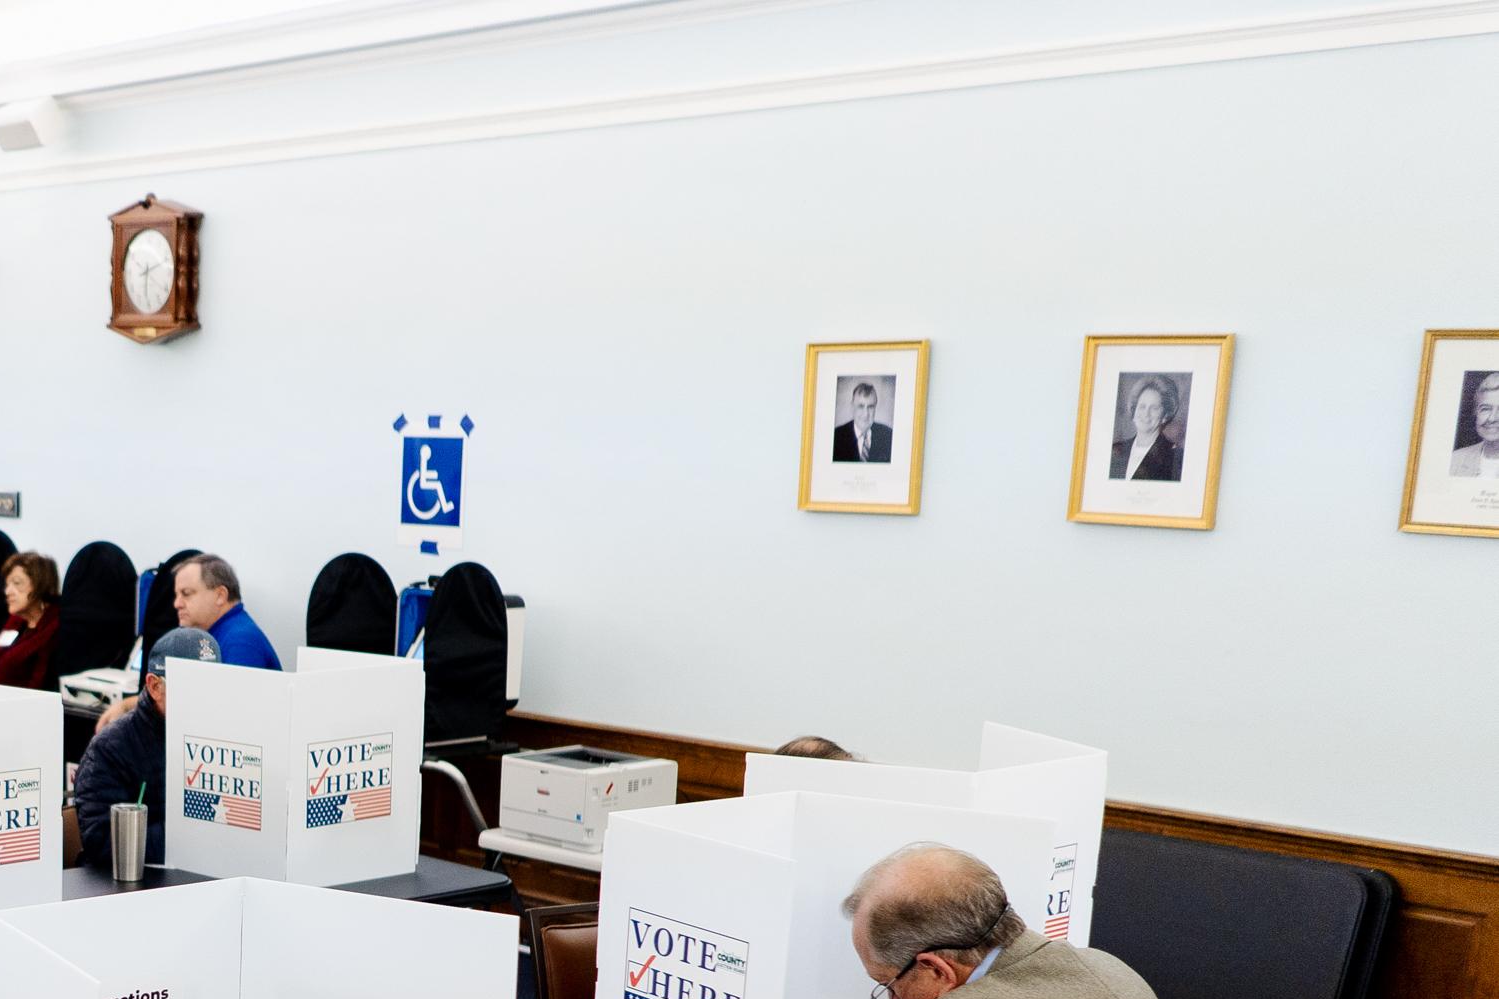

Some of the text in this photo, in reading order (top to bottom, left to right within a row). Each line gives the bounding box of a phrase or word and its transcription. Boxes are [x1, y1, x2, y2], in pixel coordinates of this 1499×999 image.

[185, 742, 243, 769] VOTE
[310, 742, 373, 769] VOTE
[201, 772, 261, 800] HERE
[326, 767, 391, 793] HERE
[630, 918, 717, 972] VOTE
[717, 953, 745, 968] COUNTY
